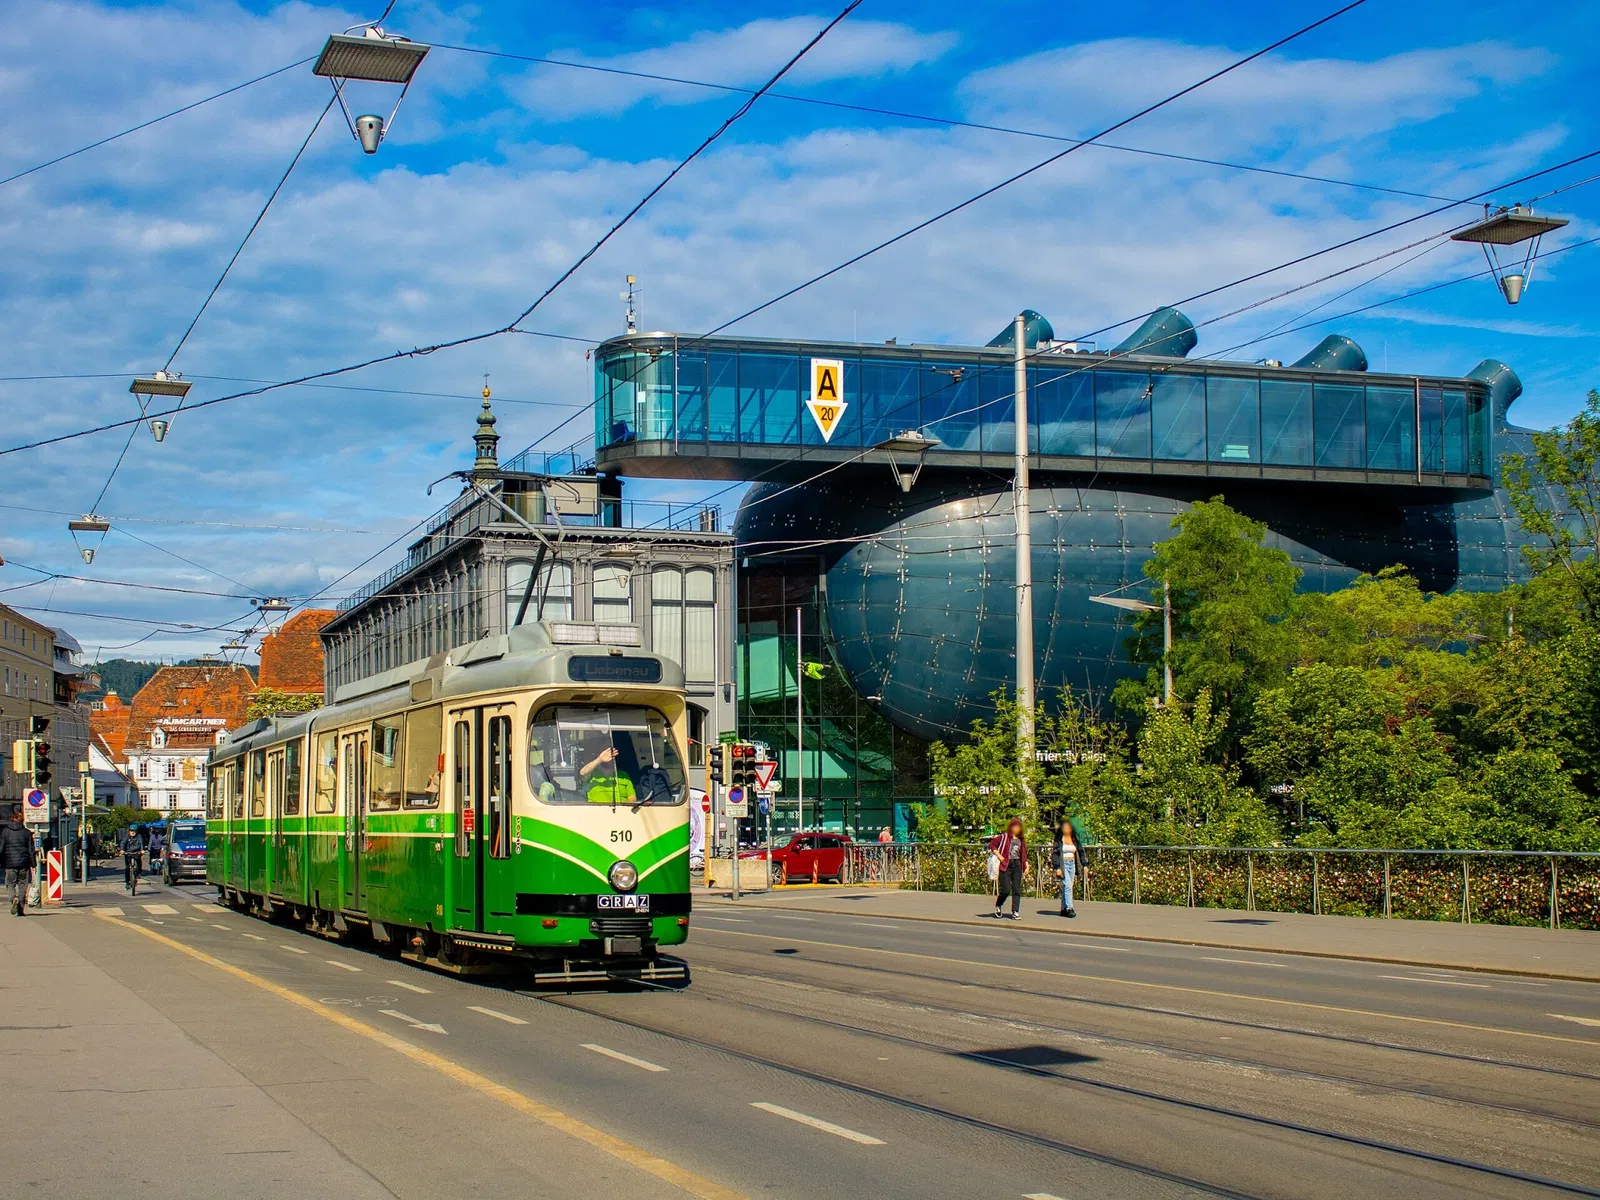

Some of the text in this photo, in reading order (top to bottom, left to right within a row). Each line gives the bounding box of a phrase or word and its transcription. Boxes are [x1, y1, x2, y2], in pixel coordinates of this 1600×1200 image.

[818, 369, 837, 397] A
[821, 407, 834, 421] 20
[610, 829, 633, 842] 510
[599, 895, 648, 908] GRAZ
